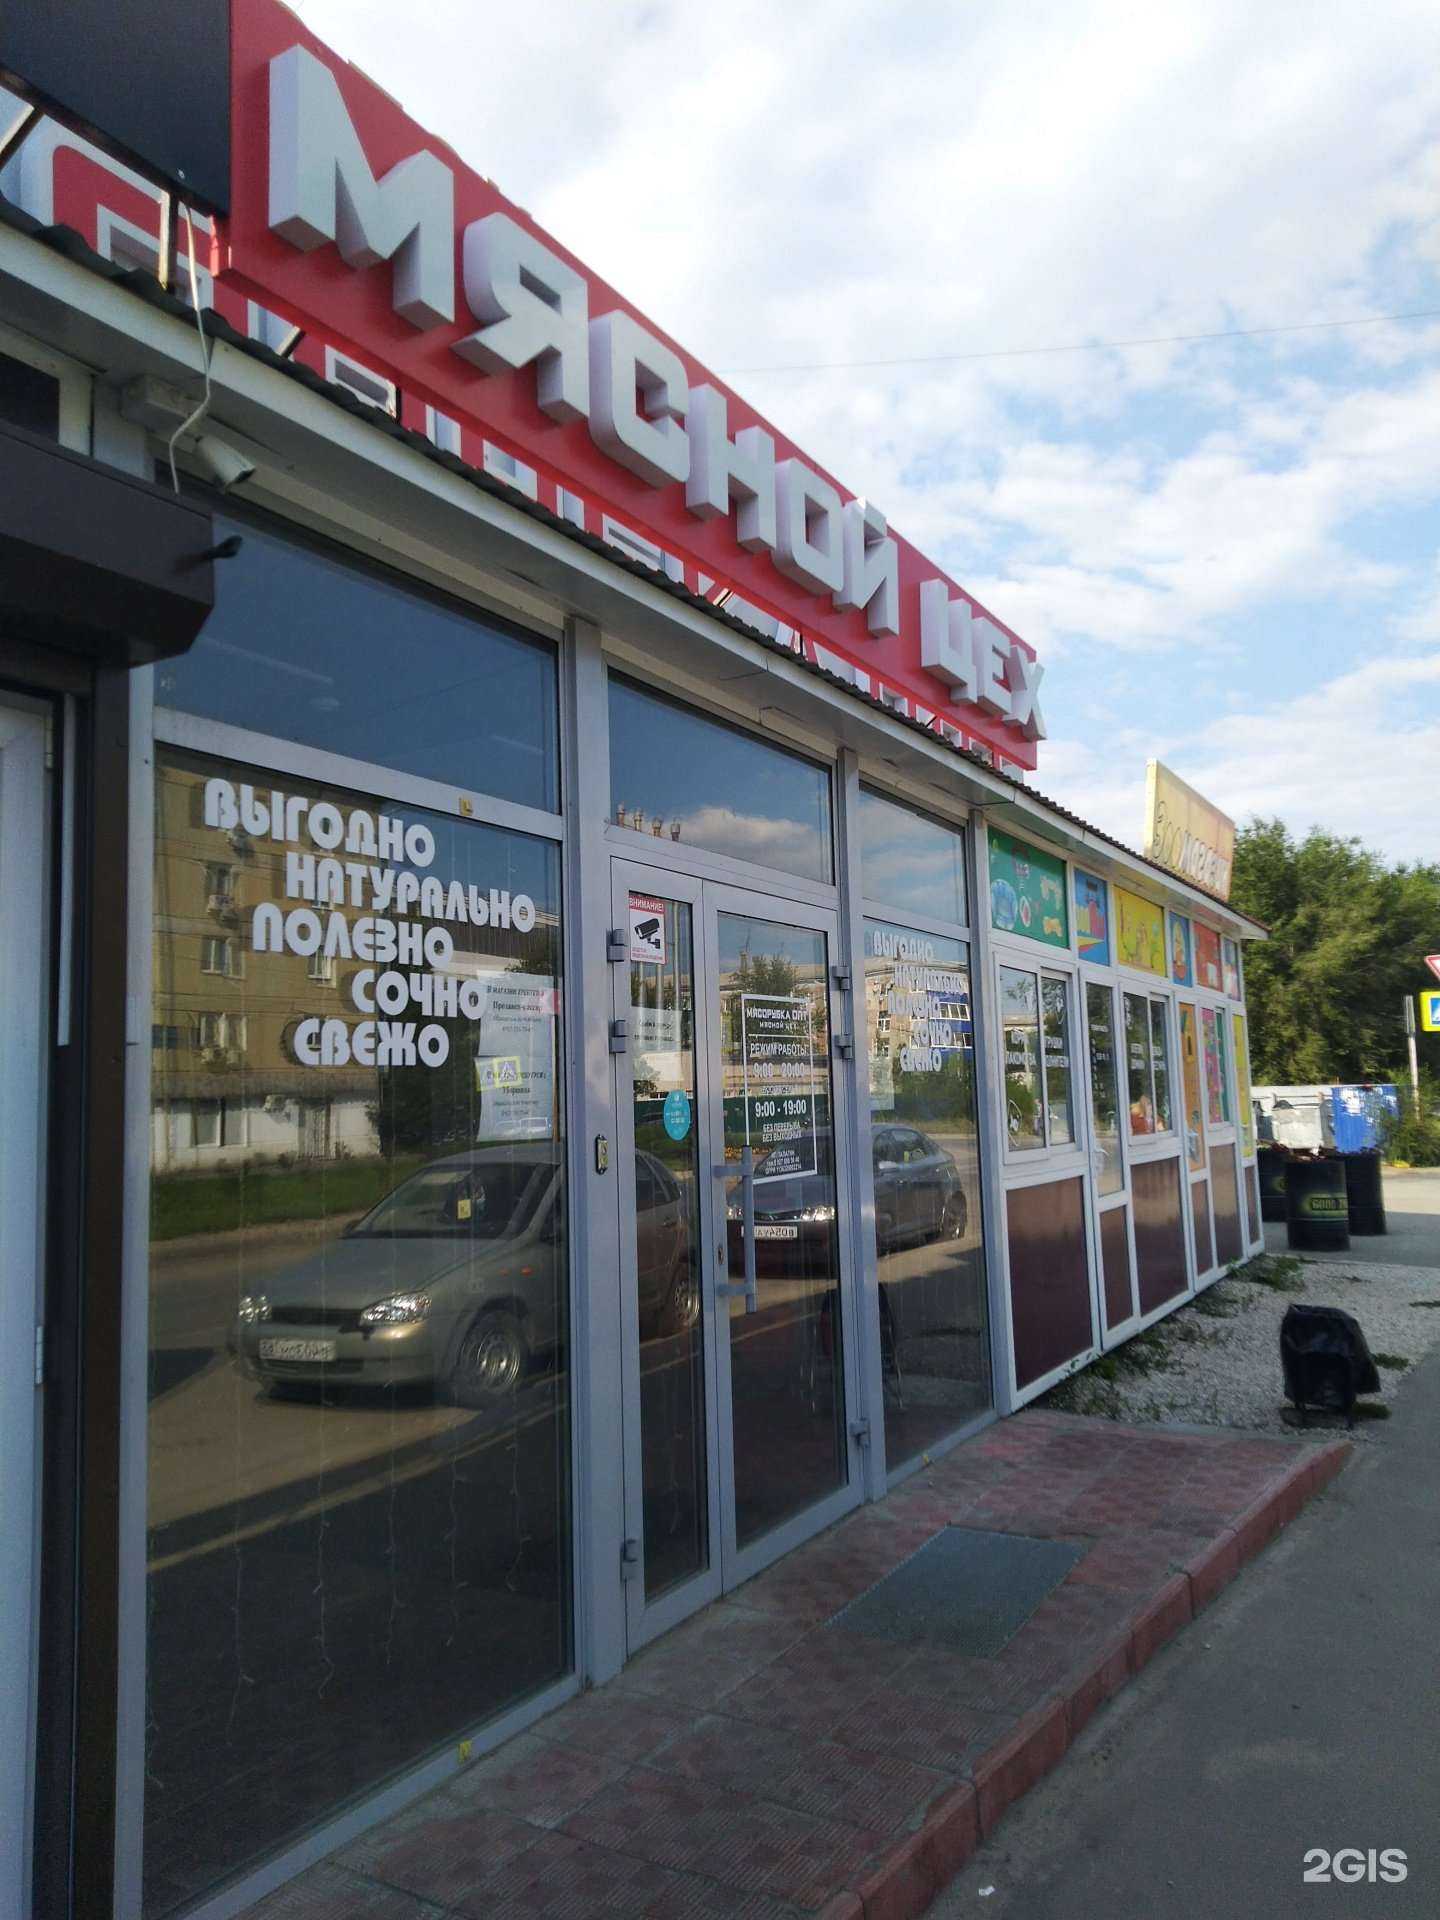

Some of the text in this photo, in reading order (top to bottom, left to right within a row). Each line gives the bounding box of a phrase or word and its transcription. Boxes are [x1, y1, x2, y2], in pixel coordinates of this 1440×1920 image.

[269, 42, 899, 638] МЯСНОЙ
[920, 578, 1047, 741] ЦЕХ
[204, 778, 436, 868] ВЫГОДНО
[286, 852, 537, 934] НАТУРАЛЬНО
[252, 902, 454, 970] ПОЛЕЗНО
[351, 969, 490, 1021] СОЧНО
[746, 1006, 791, 1020] МЯСОРУБКА
[294, 1018, 450, 1068] СВЕЖО
[755, 1101, 775, 1118] 9:00
[783, 1099, 807, 1116] 19:00
